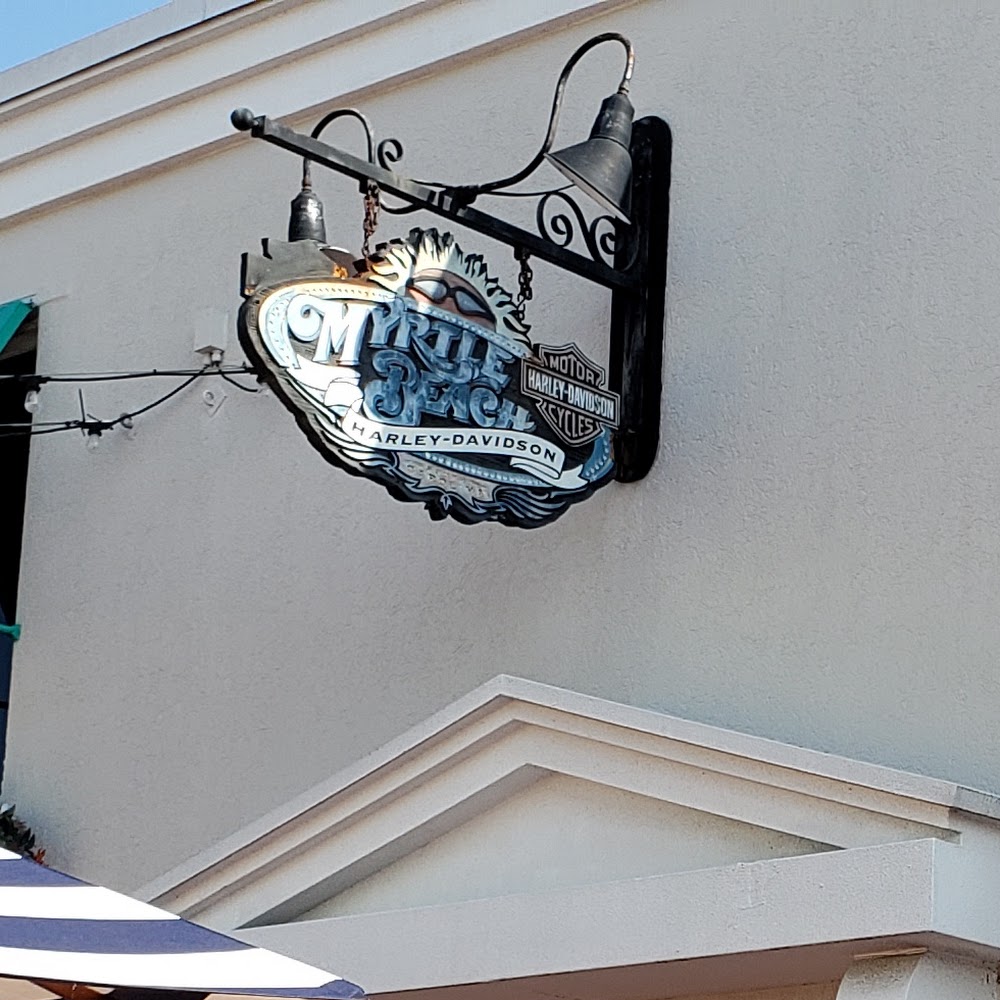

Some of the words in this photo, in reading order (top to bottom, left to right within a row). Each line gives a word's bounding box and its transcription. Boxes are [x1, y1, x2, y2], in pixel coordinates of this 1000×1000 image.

[286, 294, 516, 393] MYRTLE
[363, 350, 536, 432] BEACH
[549, 353, 595, 385] MOTOR
[527, 368, 615, 420] HARLEY-DAVIDSON
[352, 421, 557, 462] HARLEY-DAVIDSON
[548, 403, 594, 438] CYCLES
